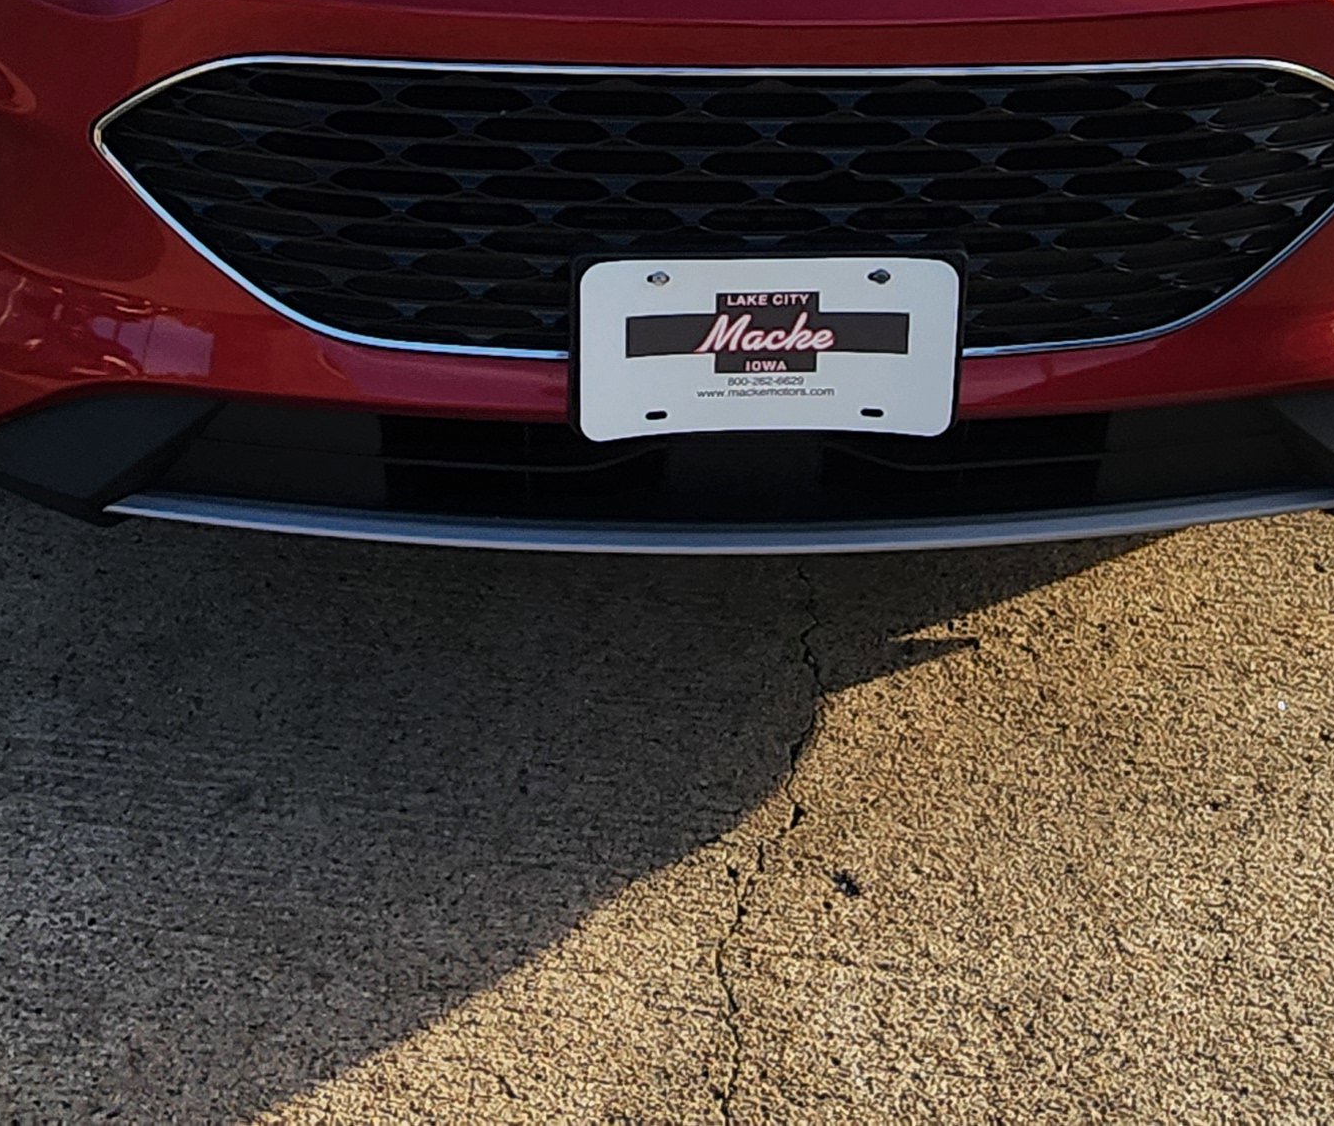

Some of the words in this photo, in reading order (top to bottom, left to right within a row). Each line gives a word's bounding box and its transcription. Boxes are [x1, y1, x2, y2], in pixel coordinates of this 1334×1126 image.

[727, 294, 768, 307] LAKE
[772, 294, 809, 306] CITY
[694, 311, 835, 353] Macke
[745, 360, 787, 372] IOWA
[697, 387, 835, 398] www.mackemotors.com
